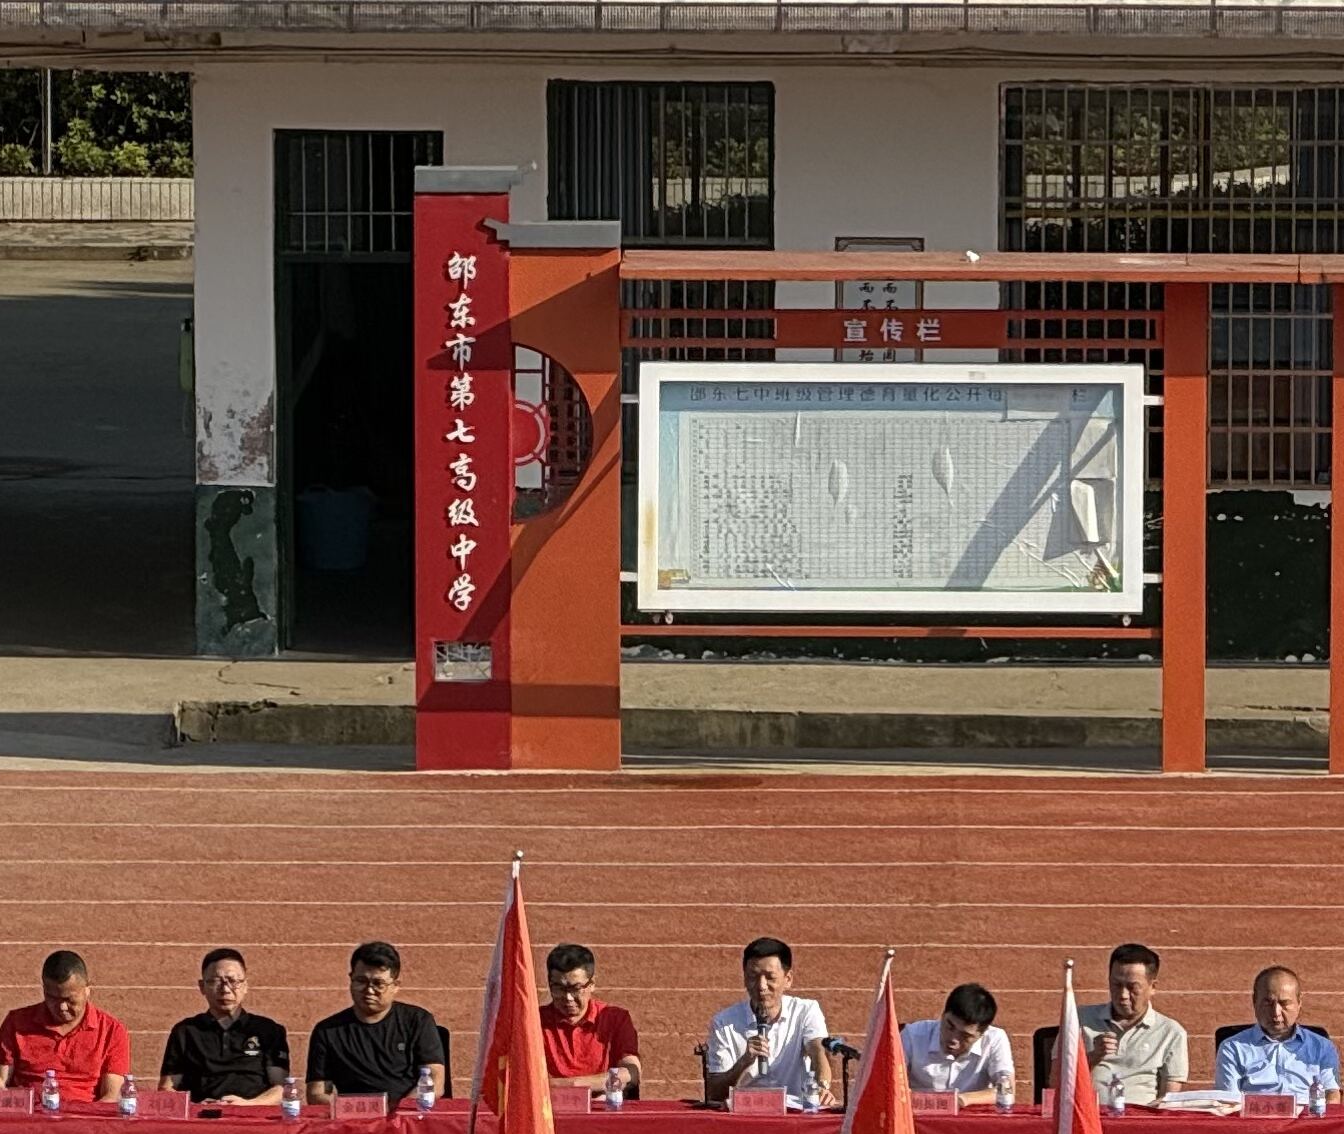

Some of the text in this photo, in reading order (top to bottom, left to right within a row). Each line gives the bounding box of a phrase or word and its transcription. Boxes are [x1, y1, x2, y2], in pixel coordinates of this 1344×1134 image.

[843, 318, 941, 342] 宣传栏
[445, 251, 480, 611] 邵东市第七高级中学
